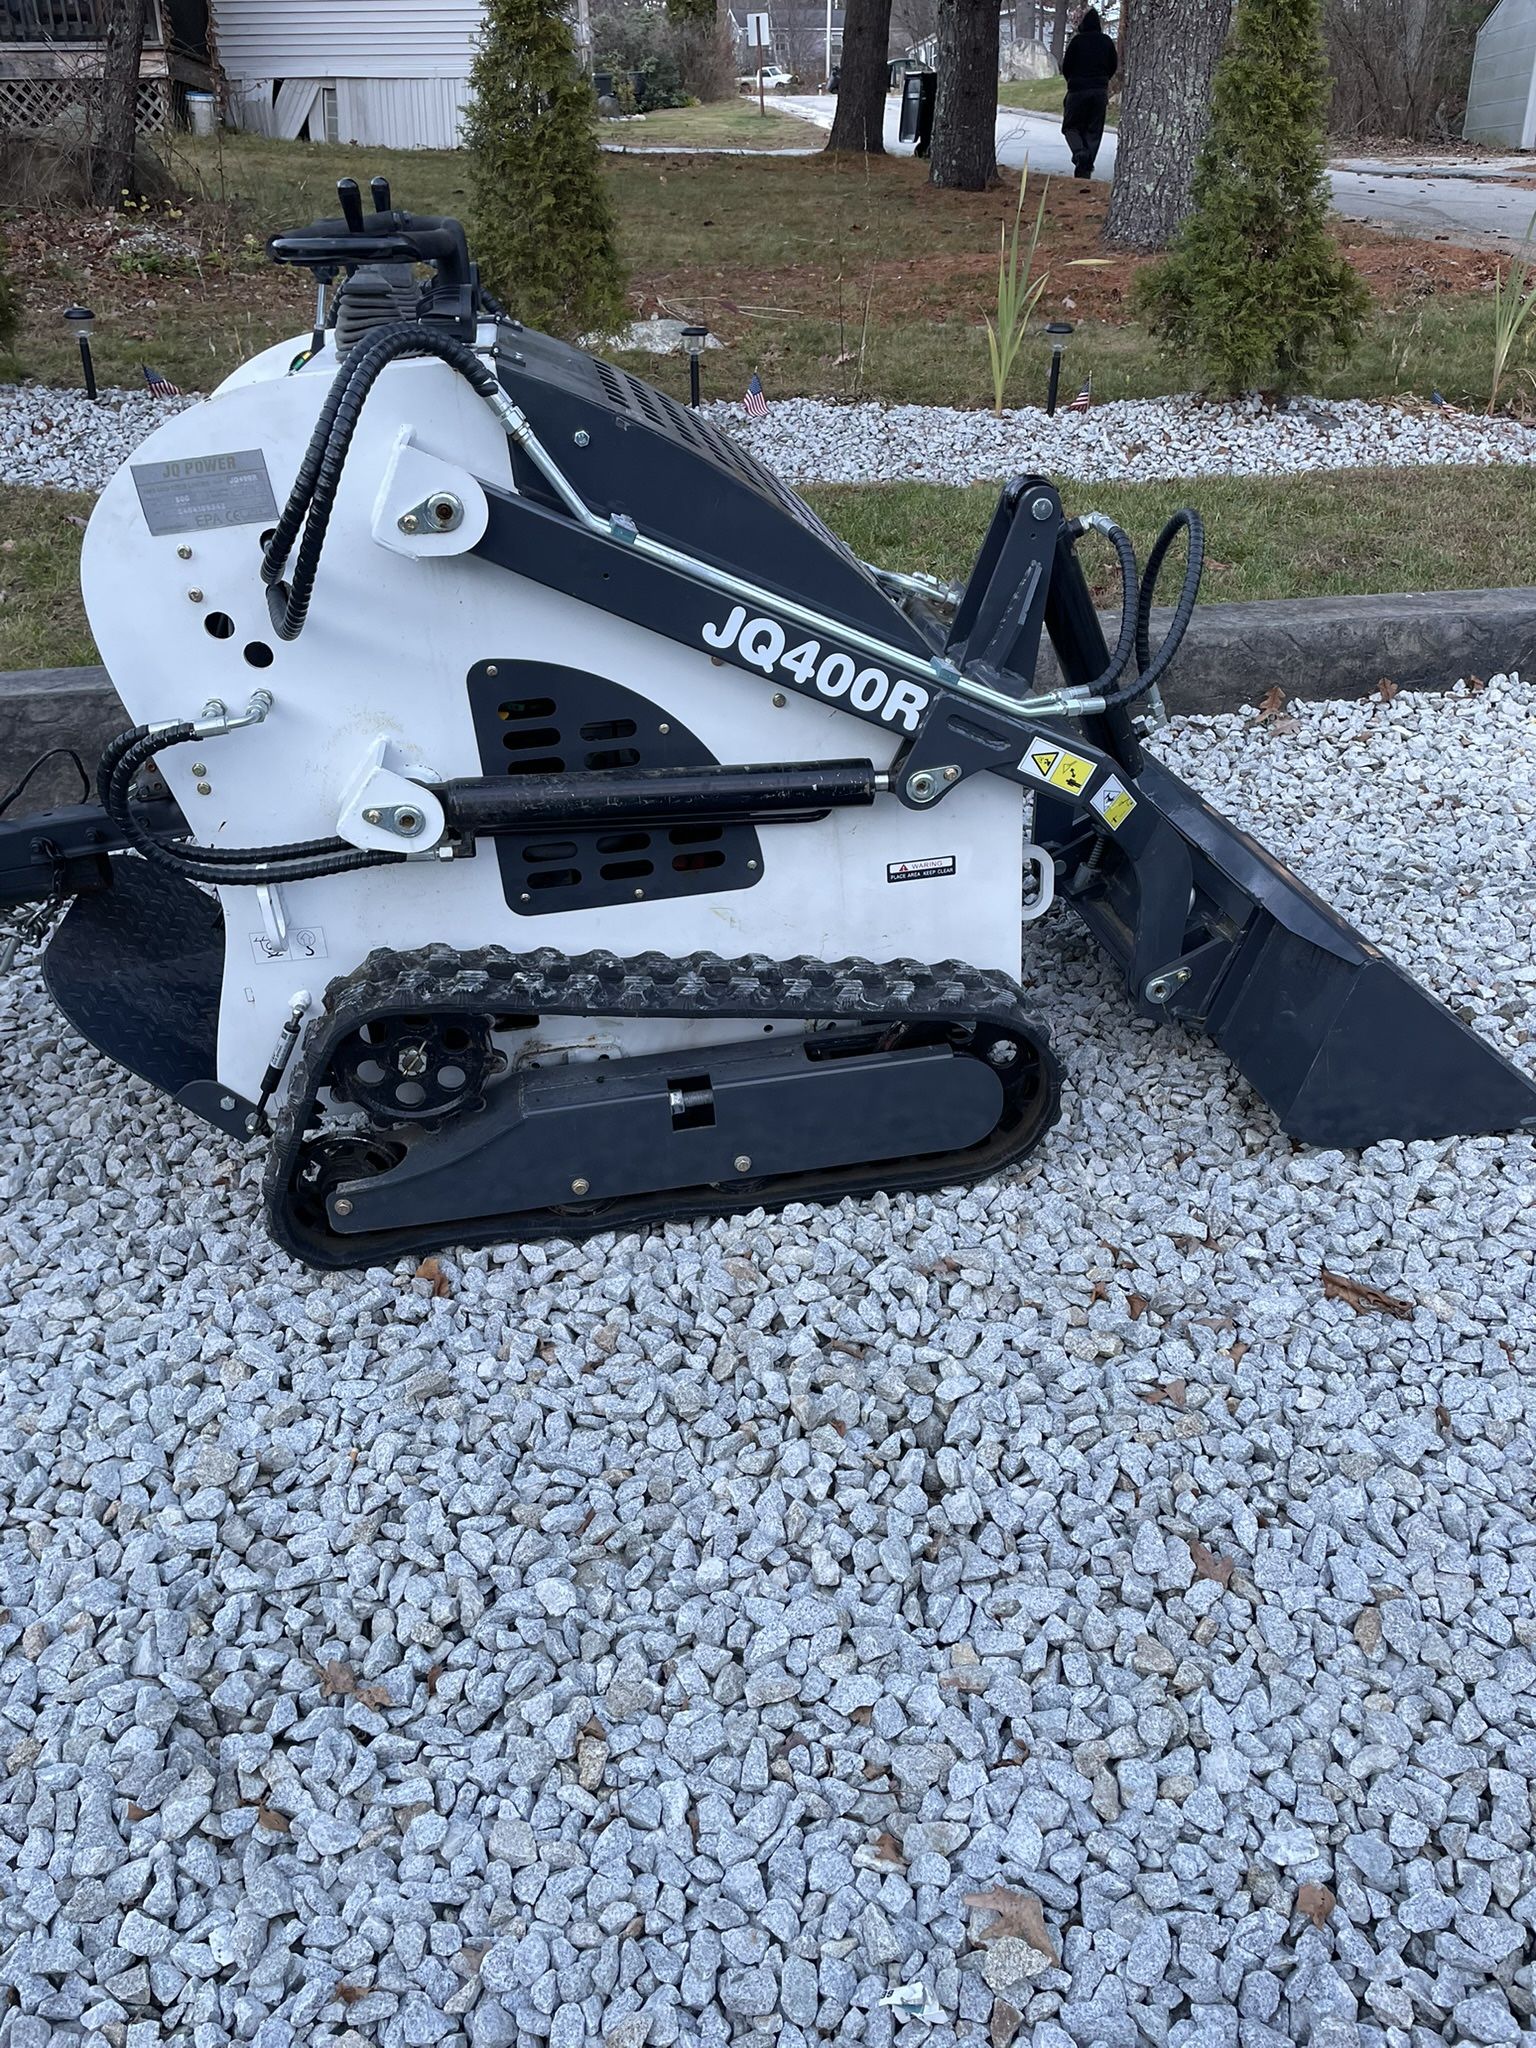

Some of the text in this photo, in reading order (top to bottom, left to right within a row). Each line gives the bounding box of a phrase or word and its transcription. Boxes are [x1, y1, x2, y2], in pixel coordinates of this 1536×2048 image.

[184, 456, 237, 475] POWER
[195, 513, 223, 527] EPA
[701, 605, 929, 731] JQ400R
[911, 860, 943, 870] WARING
